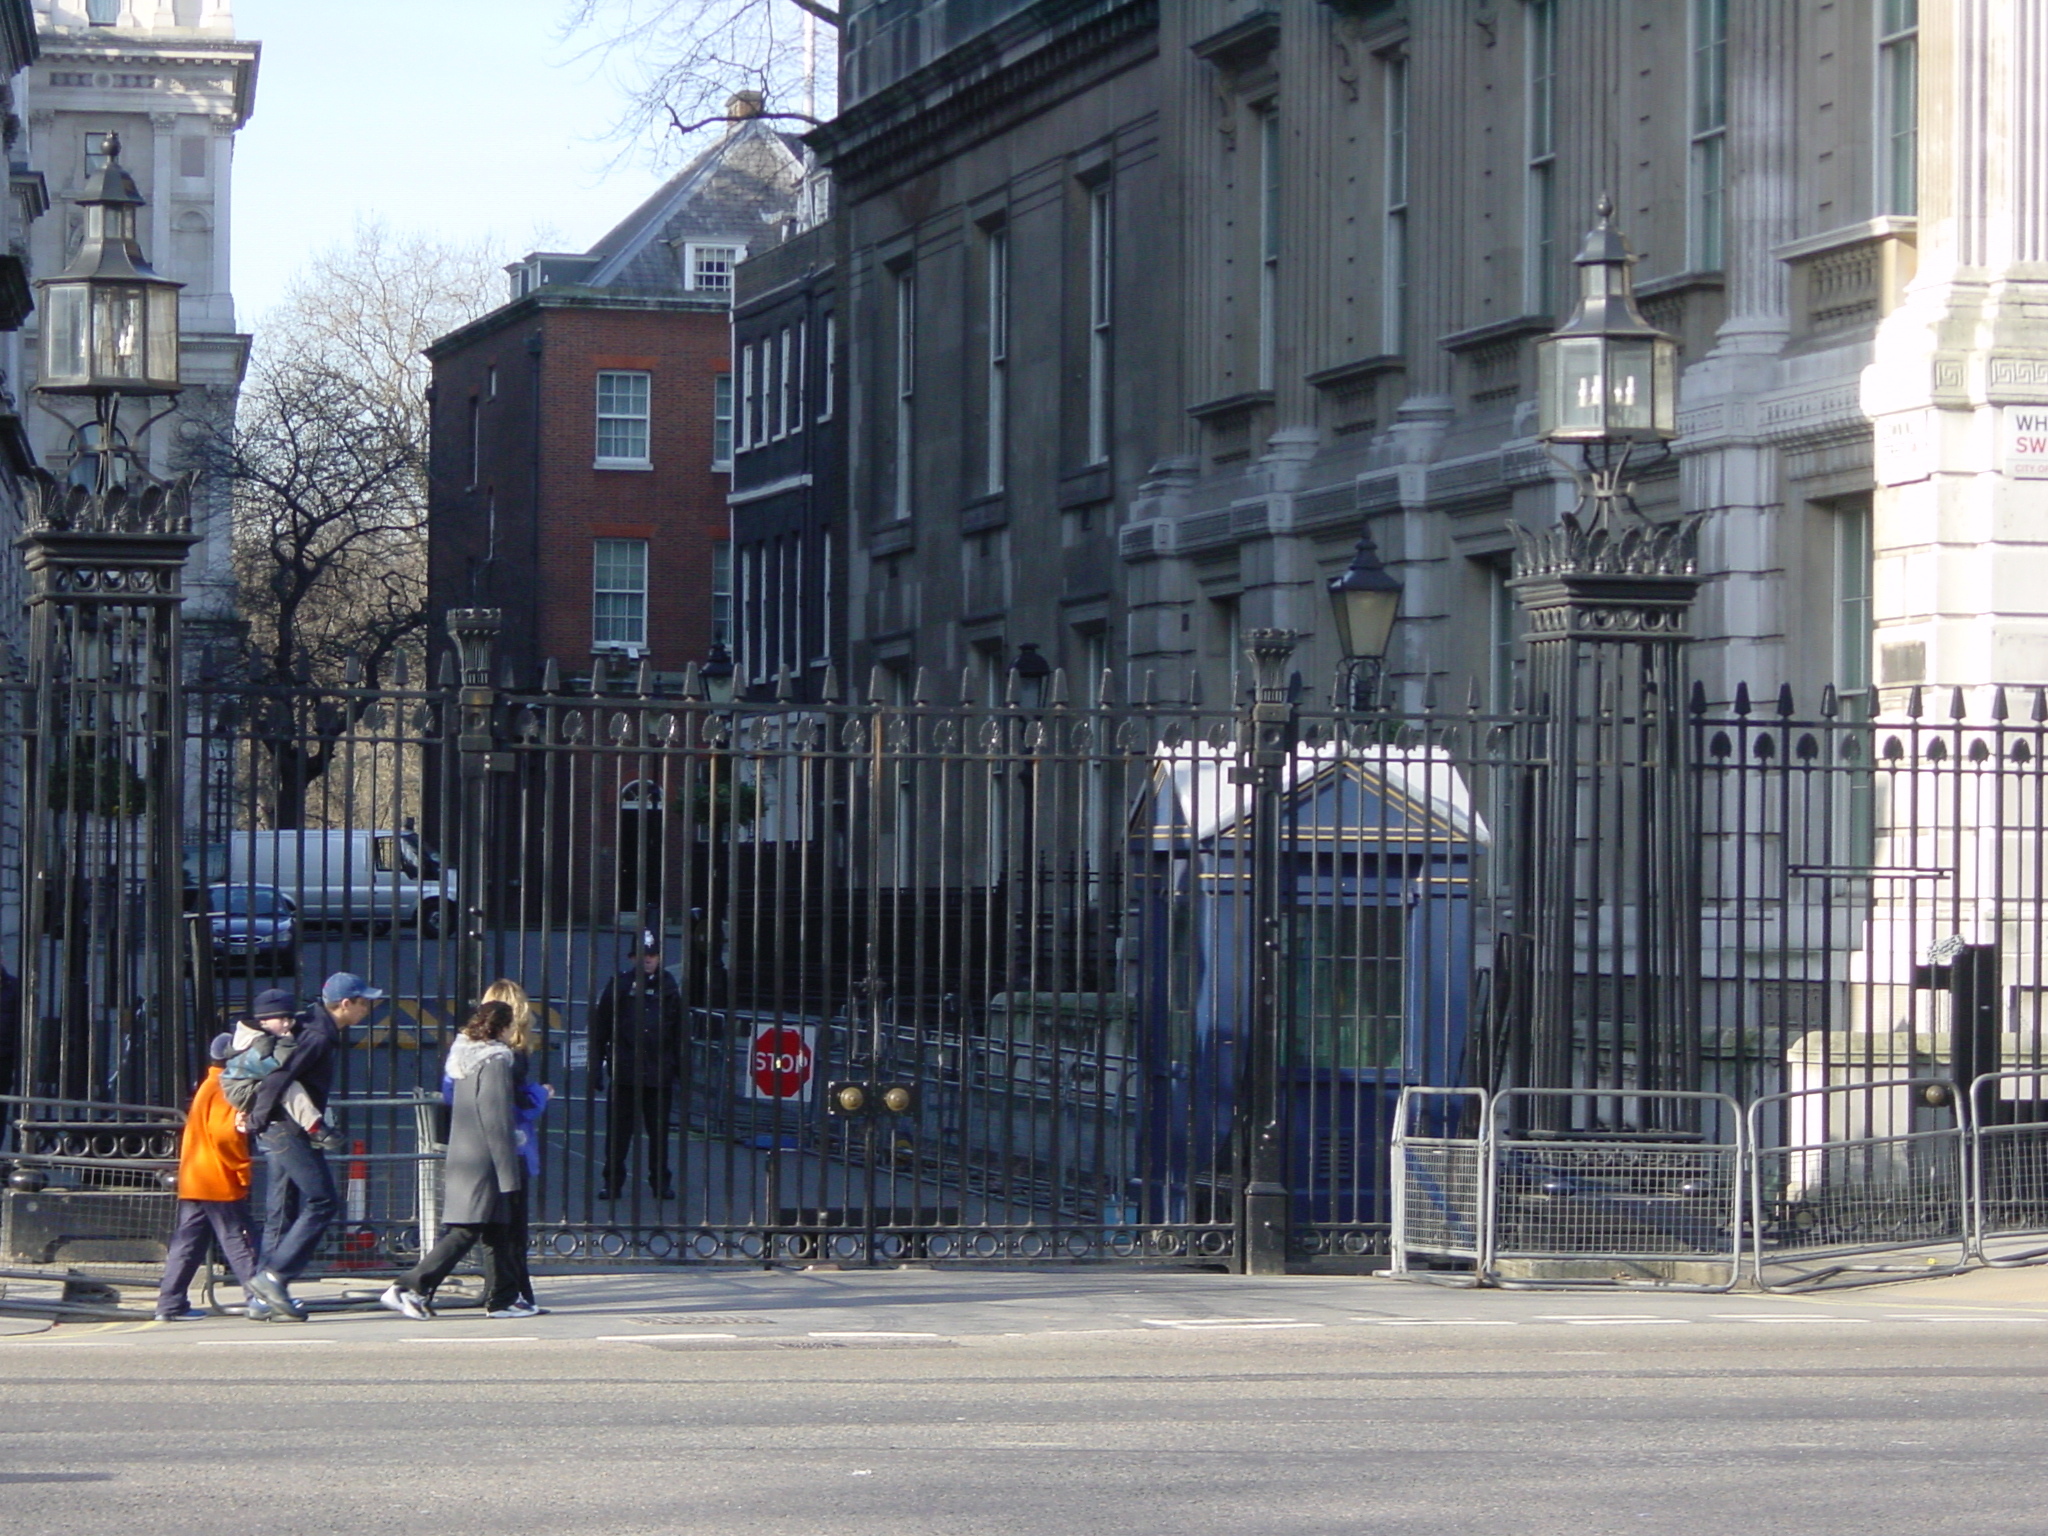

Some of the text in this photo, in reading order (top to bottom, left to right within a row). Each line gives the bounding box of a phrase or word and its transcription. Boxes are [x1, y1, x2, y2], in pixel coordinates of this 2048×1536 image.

[2016, 437, 2047, 453] SW
[2015, 464, 2035, 473] CITY
[755, 1051, 808, 1073] STOP
